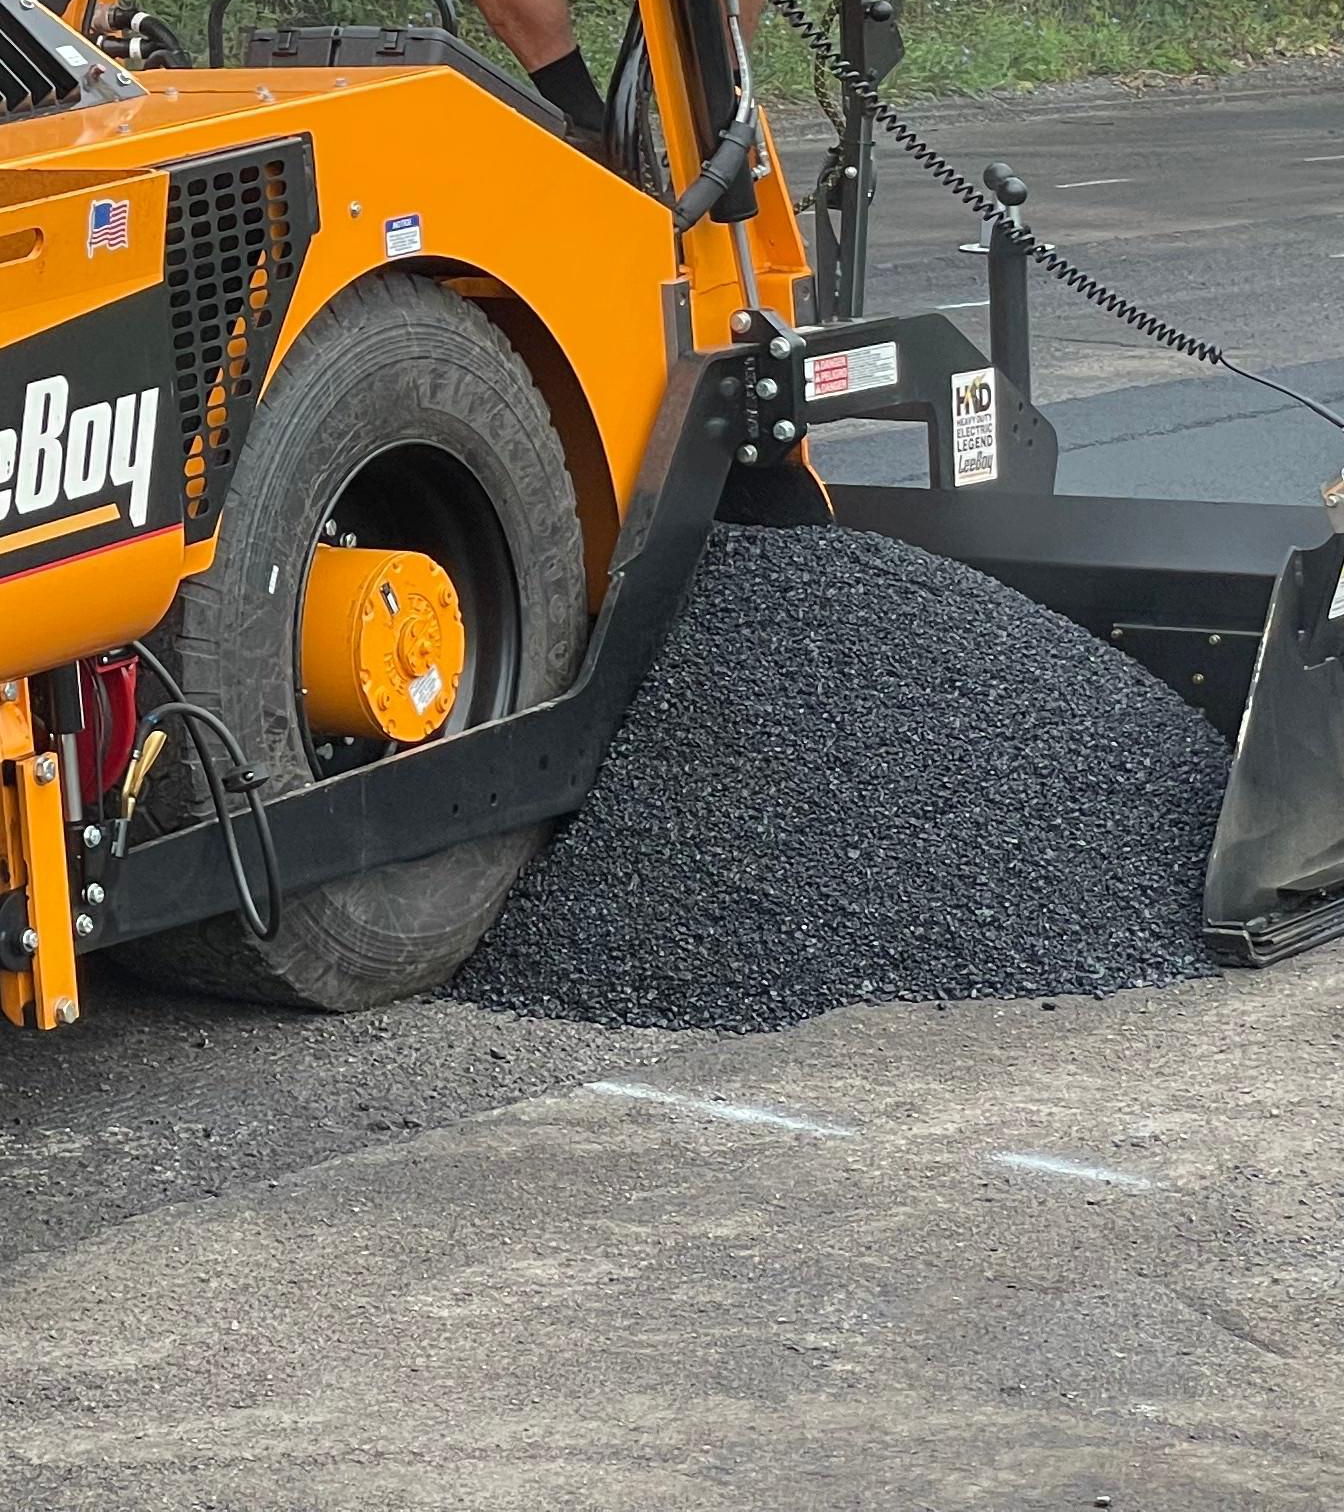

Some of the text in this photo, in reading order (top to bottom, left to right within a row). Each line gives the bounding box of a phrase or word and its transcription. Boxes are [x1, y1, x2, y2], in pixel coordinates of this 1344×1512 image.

[956, 413, 993, 427] HEAVY DUTY
[956, 423, 993, 439] ELECTRIC
[956, 434, 993, 453] LEGEND
[958, 450, 994, 474] LeeBoy
